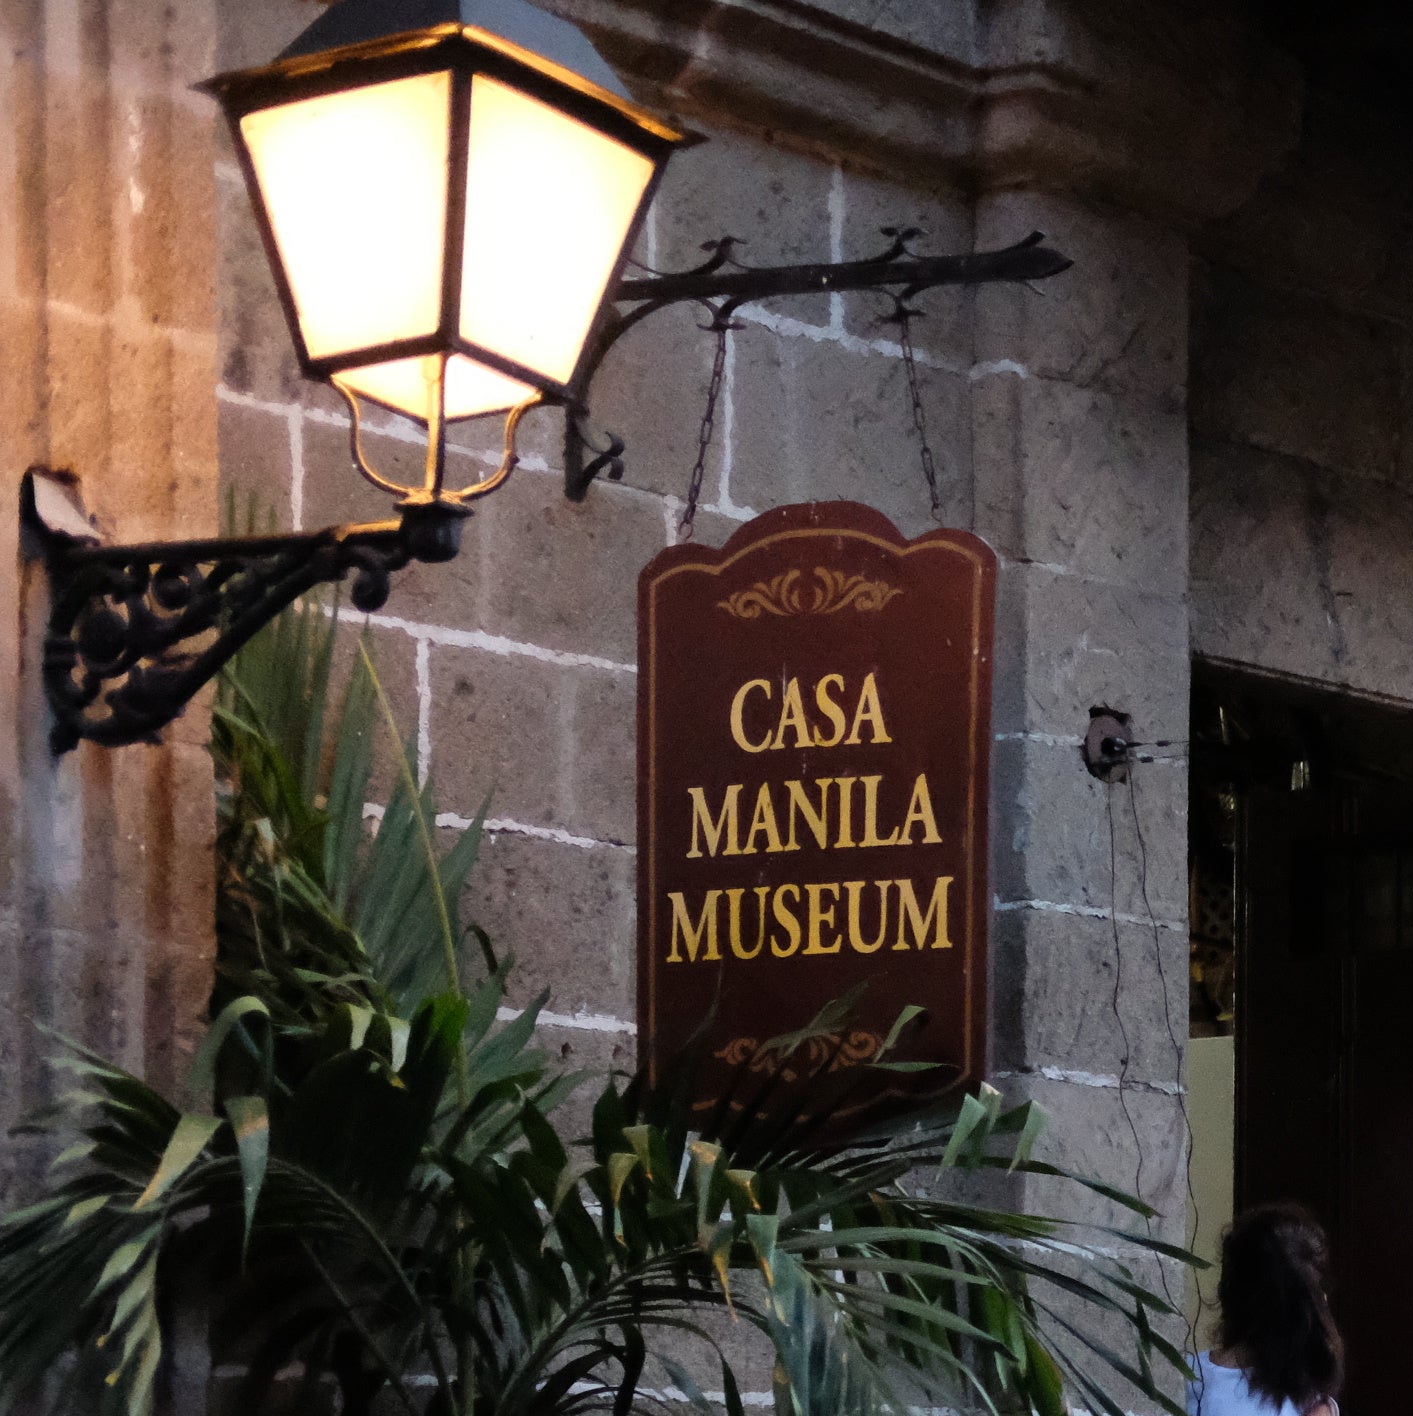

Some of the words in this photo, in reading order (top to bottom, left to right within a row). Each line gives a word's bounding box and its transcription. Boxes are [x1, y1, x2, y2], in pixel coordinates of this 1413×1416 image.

[729, 671, 893, 754] CASA
[685, 773, 943, 859] MANILA
[665, 876, 955, 964] MUSEUM
